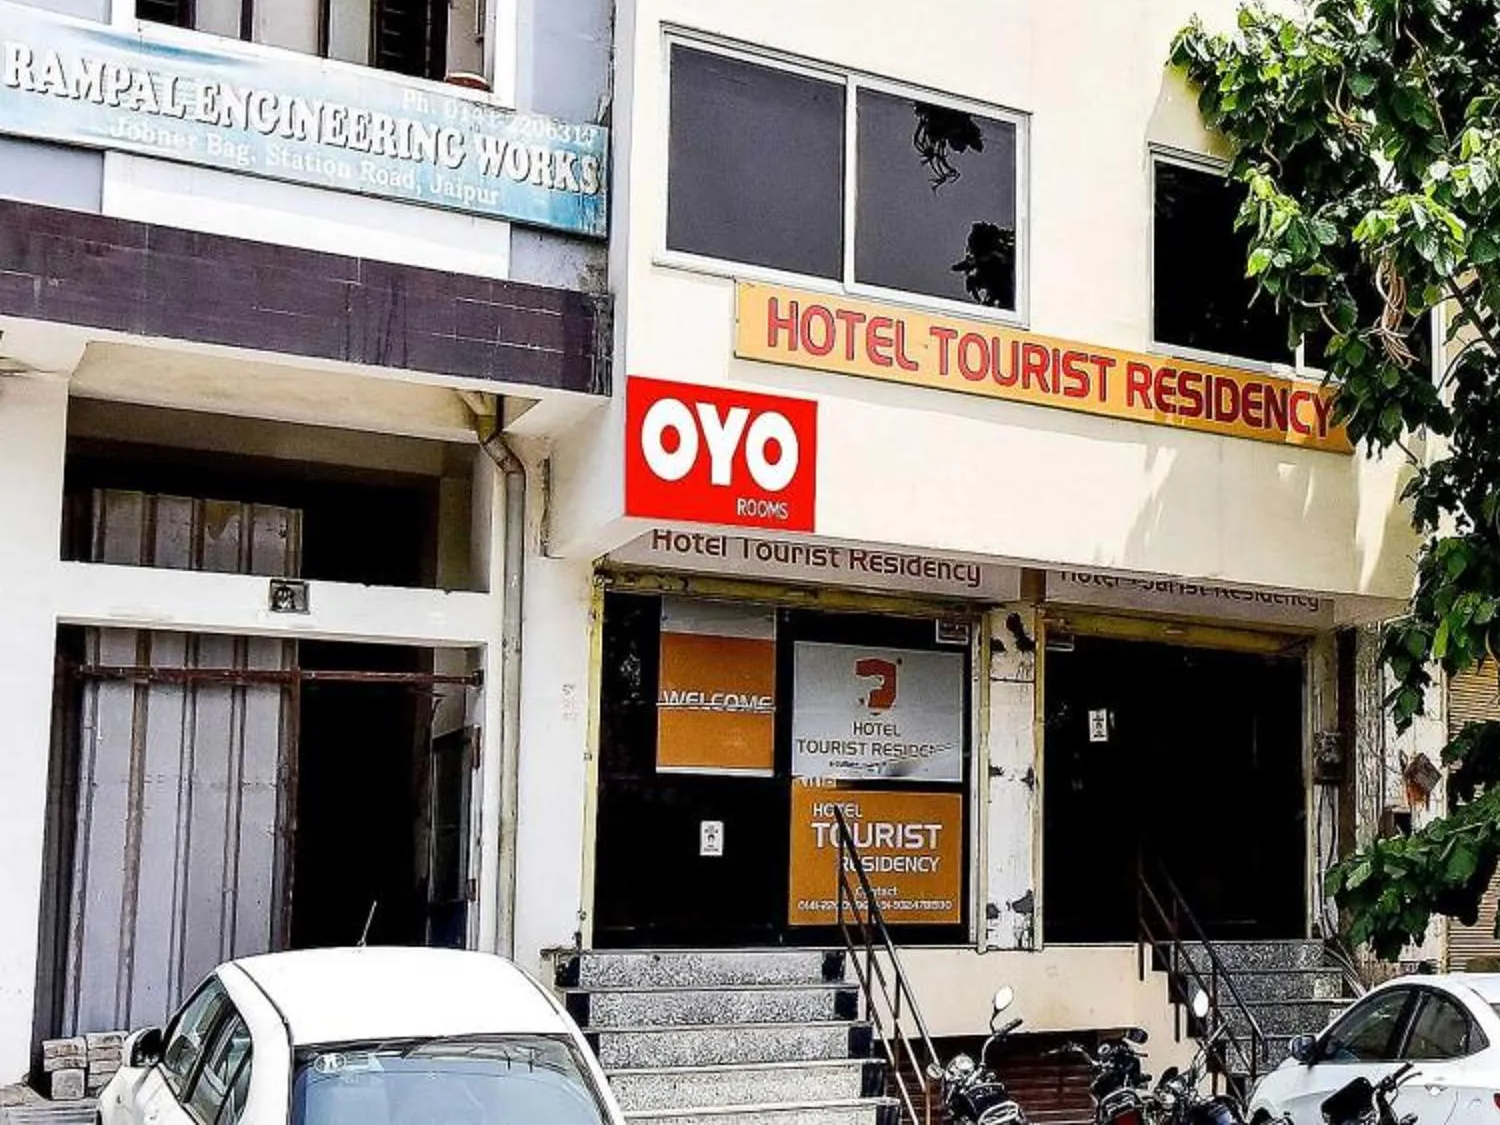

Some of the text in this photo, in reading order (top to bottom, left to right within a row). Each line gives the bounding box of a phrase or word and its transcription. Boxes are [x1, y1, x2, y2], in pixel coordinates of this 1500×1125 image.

[4, 42, 187, 120] RAMPAL
[474, 133, 600, 196] WORKS
[266, 143, 353, 177] Station
[430, 172, 499, 205] Jaipur
[767, 297, 1335, 438] HOTEL TOURIST RESIDENCY
[641, 397, 799, 492] OYO
[737, 497, 789, 520] ROOMS
[652, 528, 981, 587] Hotel Tourist Residency
[797, 739, 868, 756] TOURIST
[853, 722, 901, 737] HOTEL
